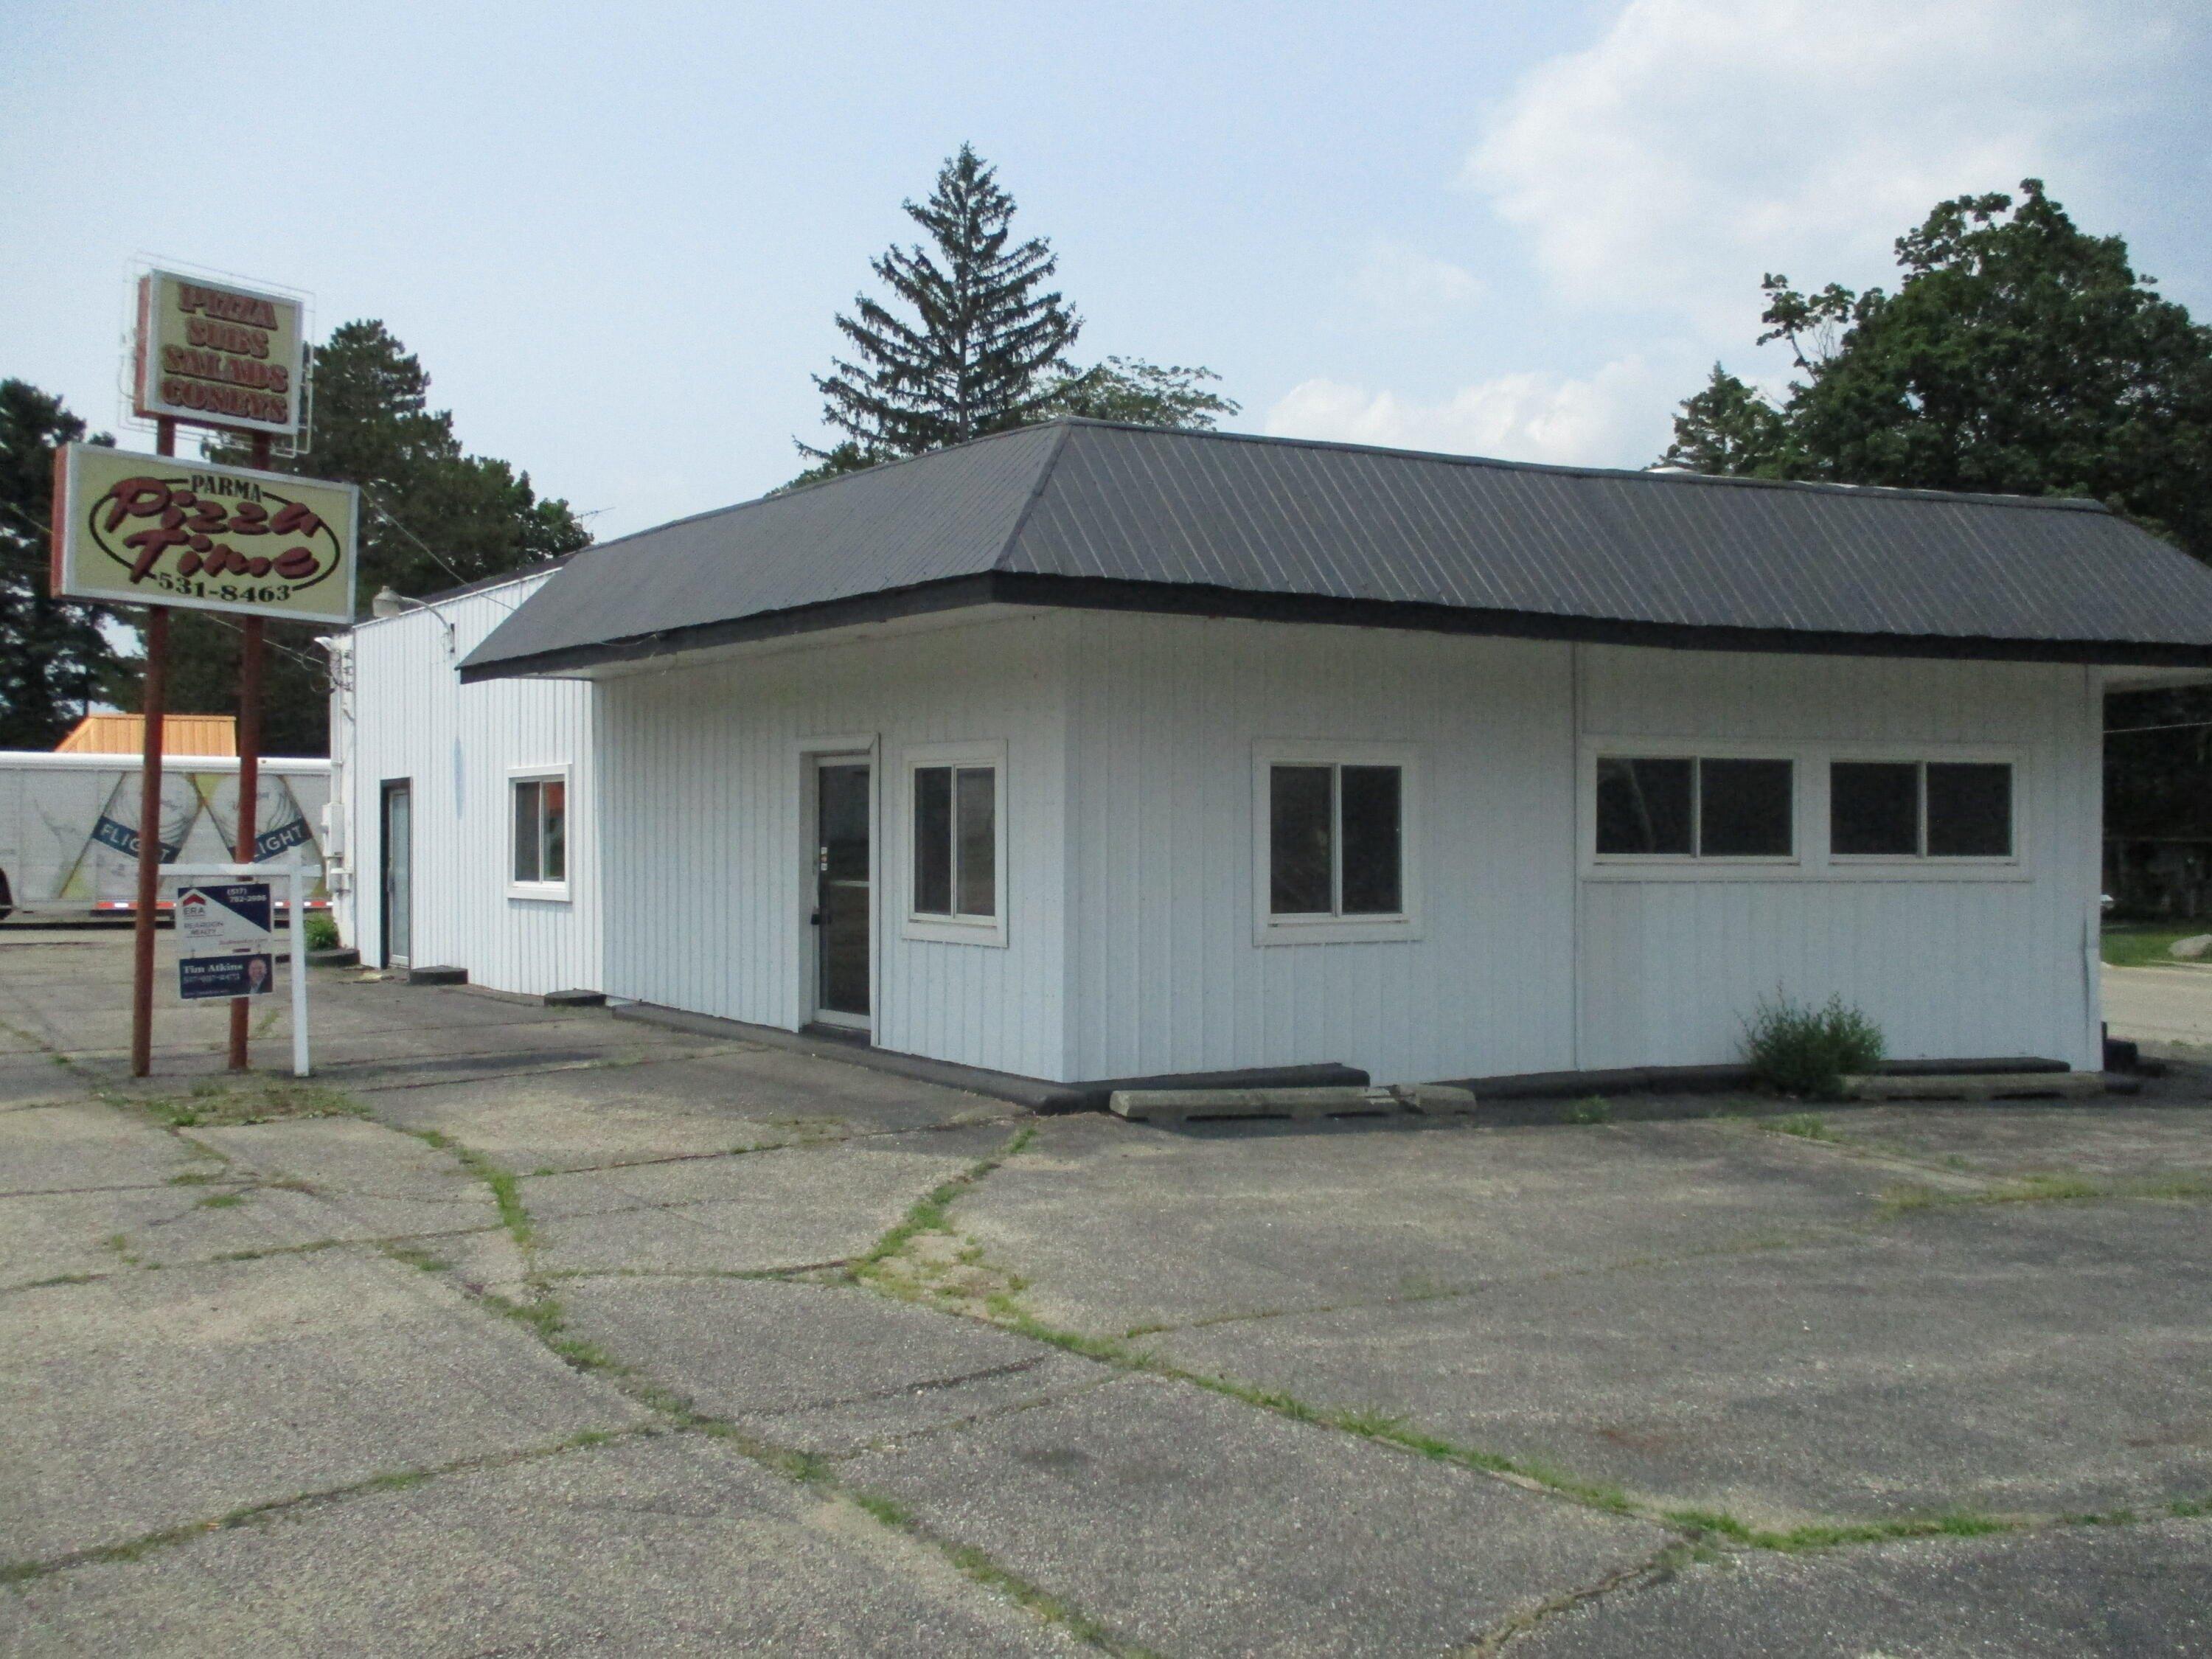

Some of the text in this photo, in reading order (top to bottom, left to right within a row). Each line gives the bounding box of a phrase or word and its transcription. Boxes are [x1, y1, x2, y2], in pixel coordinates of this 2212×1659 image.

[187, 317, 269, 359] SUBS
[164, 344, 288, 393] SALADS
[162, 377, 288, 424] CONEYS
[105, 476, 320, 538] Pizza
[192, 475, 261, 502] PARMA
[123, 528, 319, 584] Time
[158, 572, 291, 602] 531-8463
[100, 824, 170, 862] FLIGT
[209, 963, 243, 972] Atkins
